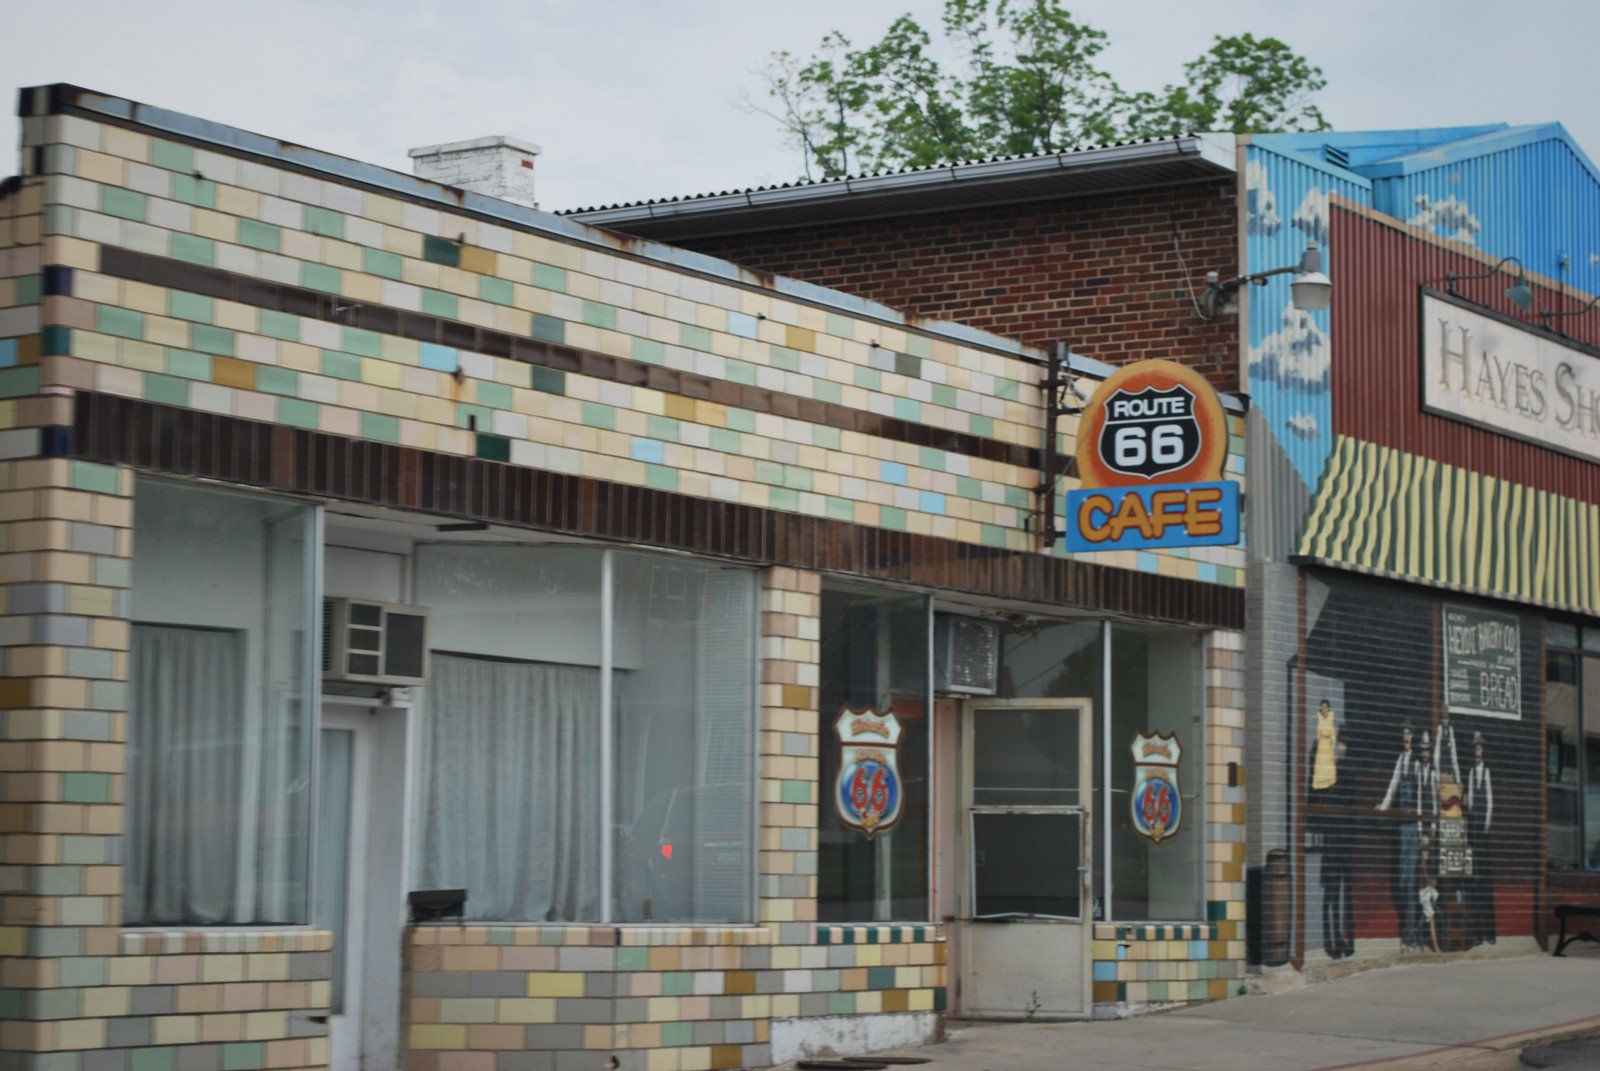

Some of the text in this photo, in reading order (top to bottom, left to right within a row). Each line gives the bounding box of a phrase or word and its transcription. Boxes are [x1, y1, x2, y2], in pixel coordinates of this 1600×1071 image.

[1438, 318, 1600, 438] HAYES SH
[1114, 397, 1185, 418] ROUTE
[1114, 424, 1184, 467] 66
[1078, 488, 1222, 543] CAFE
[1480, 671, 1517, 709] BREAD
[851, 766, 889, 812] 66
[1143, 785, 1172, 824] 66
